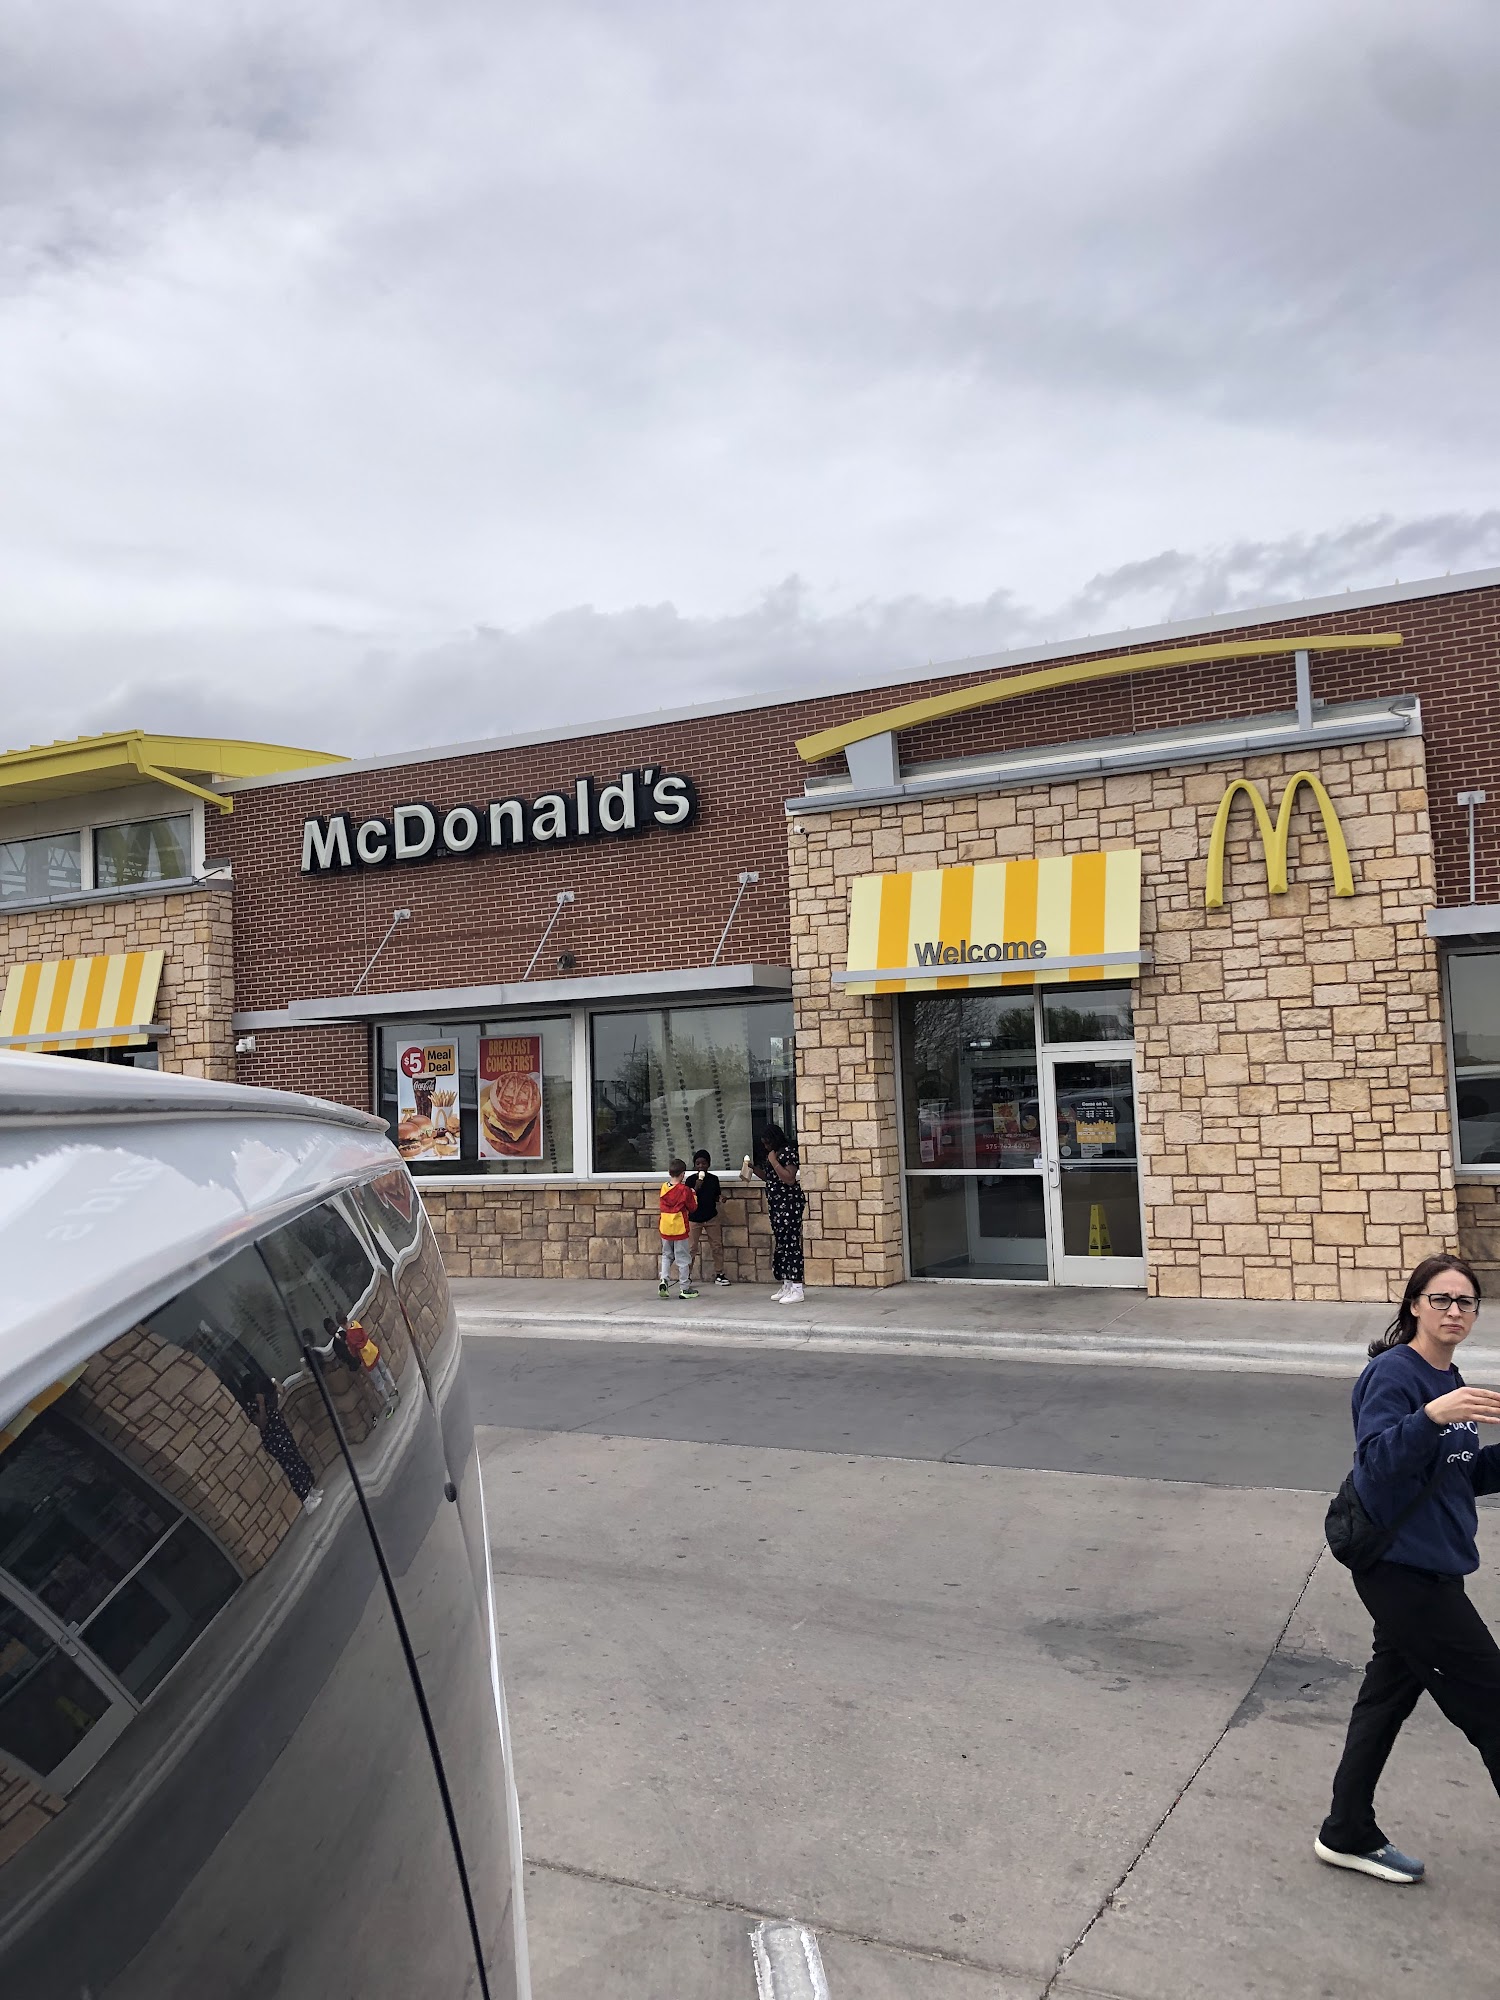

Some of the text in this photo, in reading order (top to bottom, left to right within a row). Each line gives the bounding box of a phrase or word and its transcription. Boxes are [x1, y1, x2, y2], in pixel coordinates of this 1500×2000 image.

[300, 767, 691, 873] McDonald's
[914, 939, 1047, 966] Welcome
[427, 1048, 451, 1060] Meal
[488, 1038, 531, 1056] BREAKFAST
[404, 1052, 422, 1073] $5
[428, 1061, 451, 1072] Deal
[486, 1055, 534, 1072] COMES FIRST
